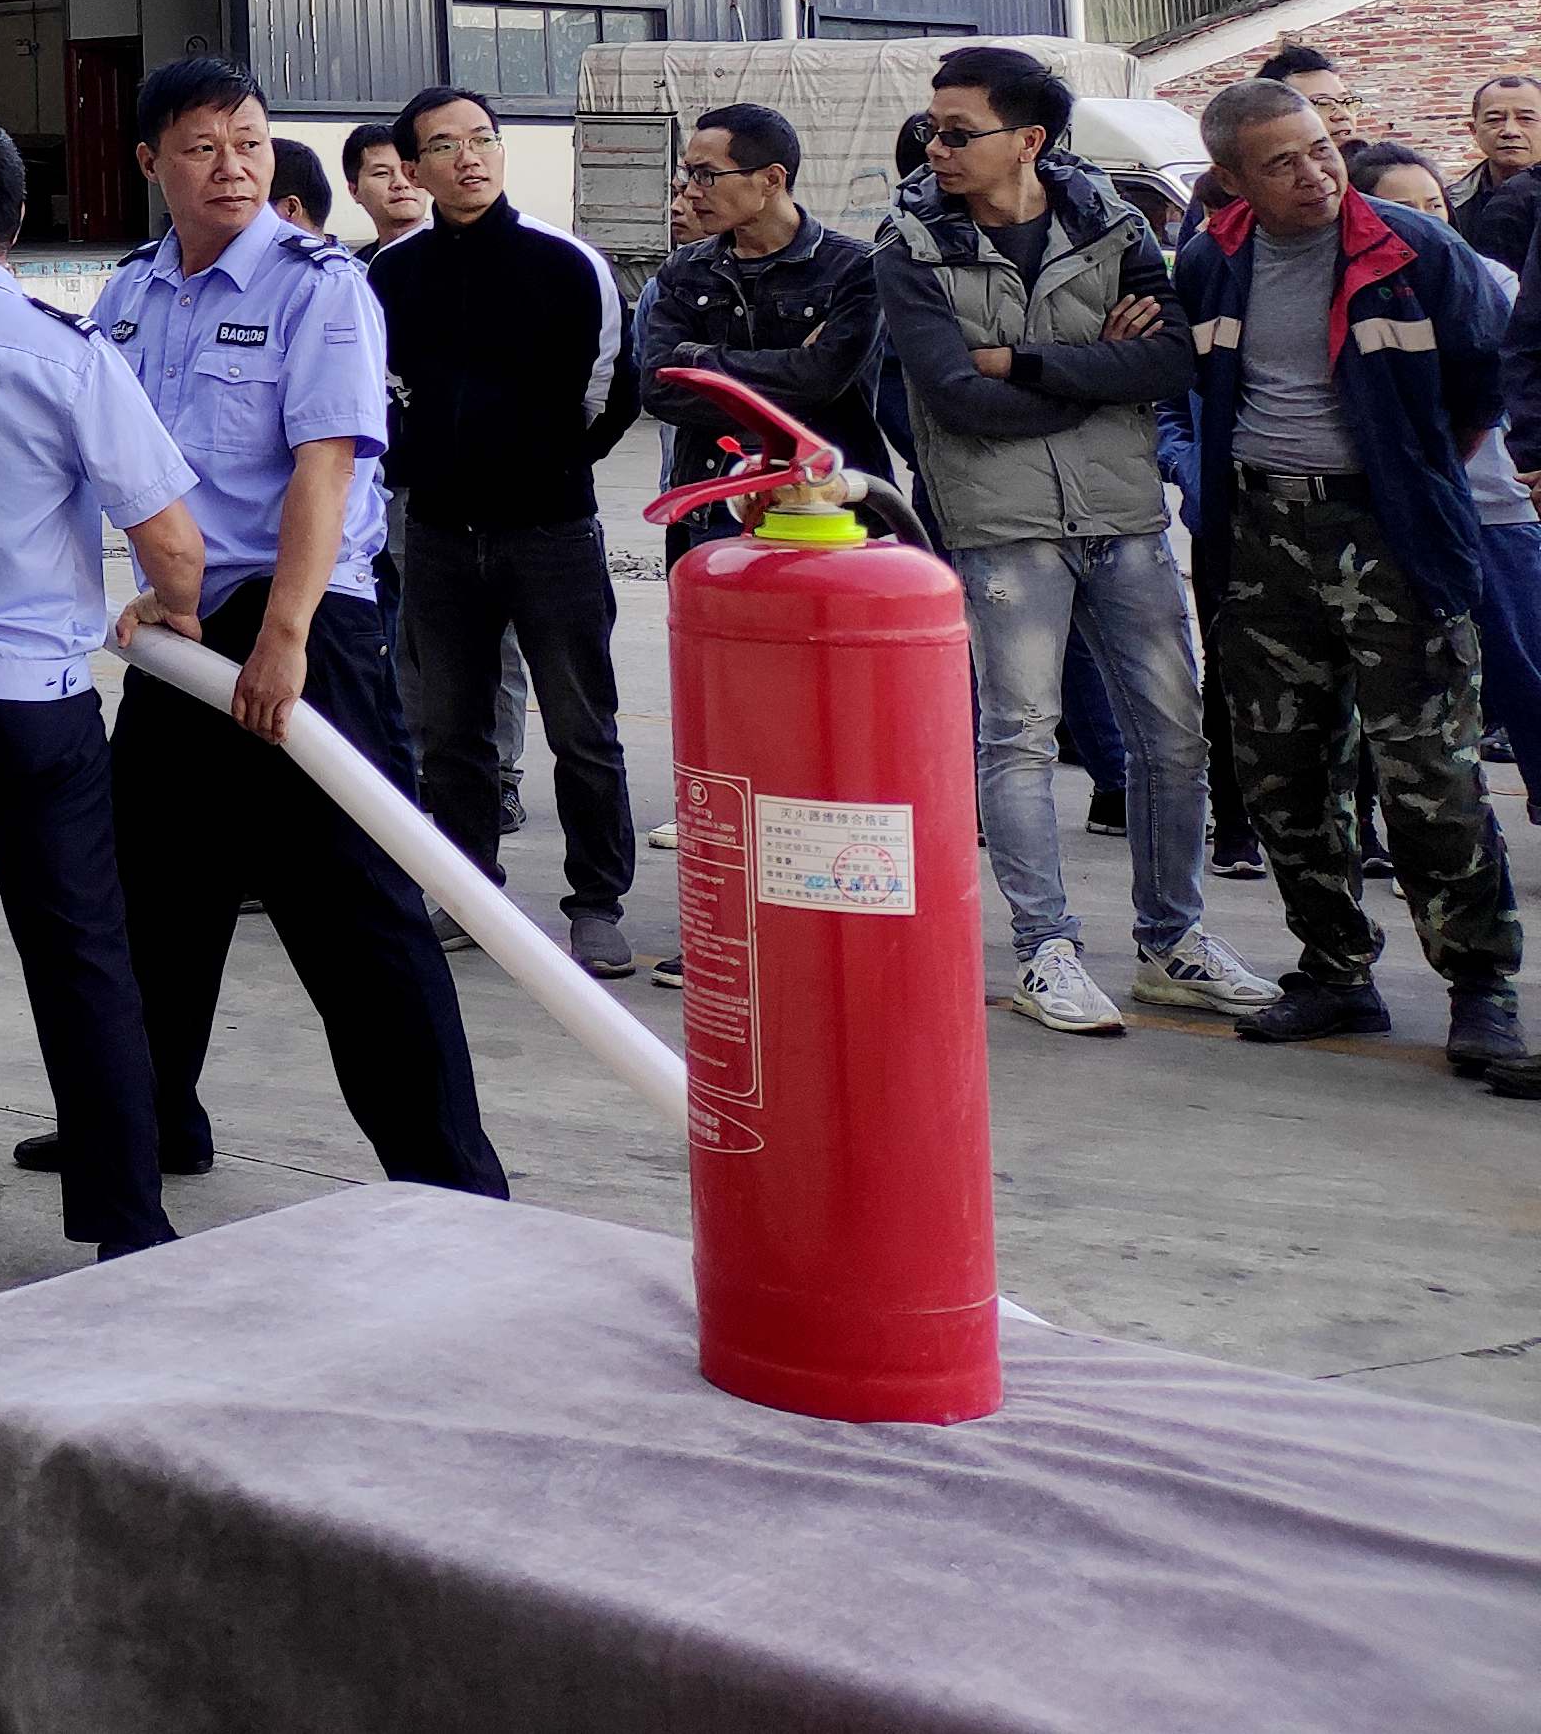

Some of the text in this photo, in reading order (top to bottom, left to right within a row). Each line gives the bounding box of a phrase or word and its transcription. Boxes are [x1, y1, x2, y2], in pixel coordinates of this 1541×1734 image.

[219, 326, 265, 343] BA0108
[780, 807, 890, 827] 灭火器维修合格证
